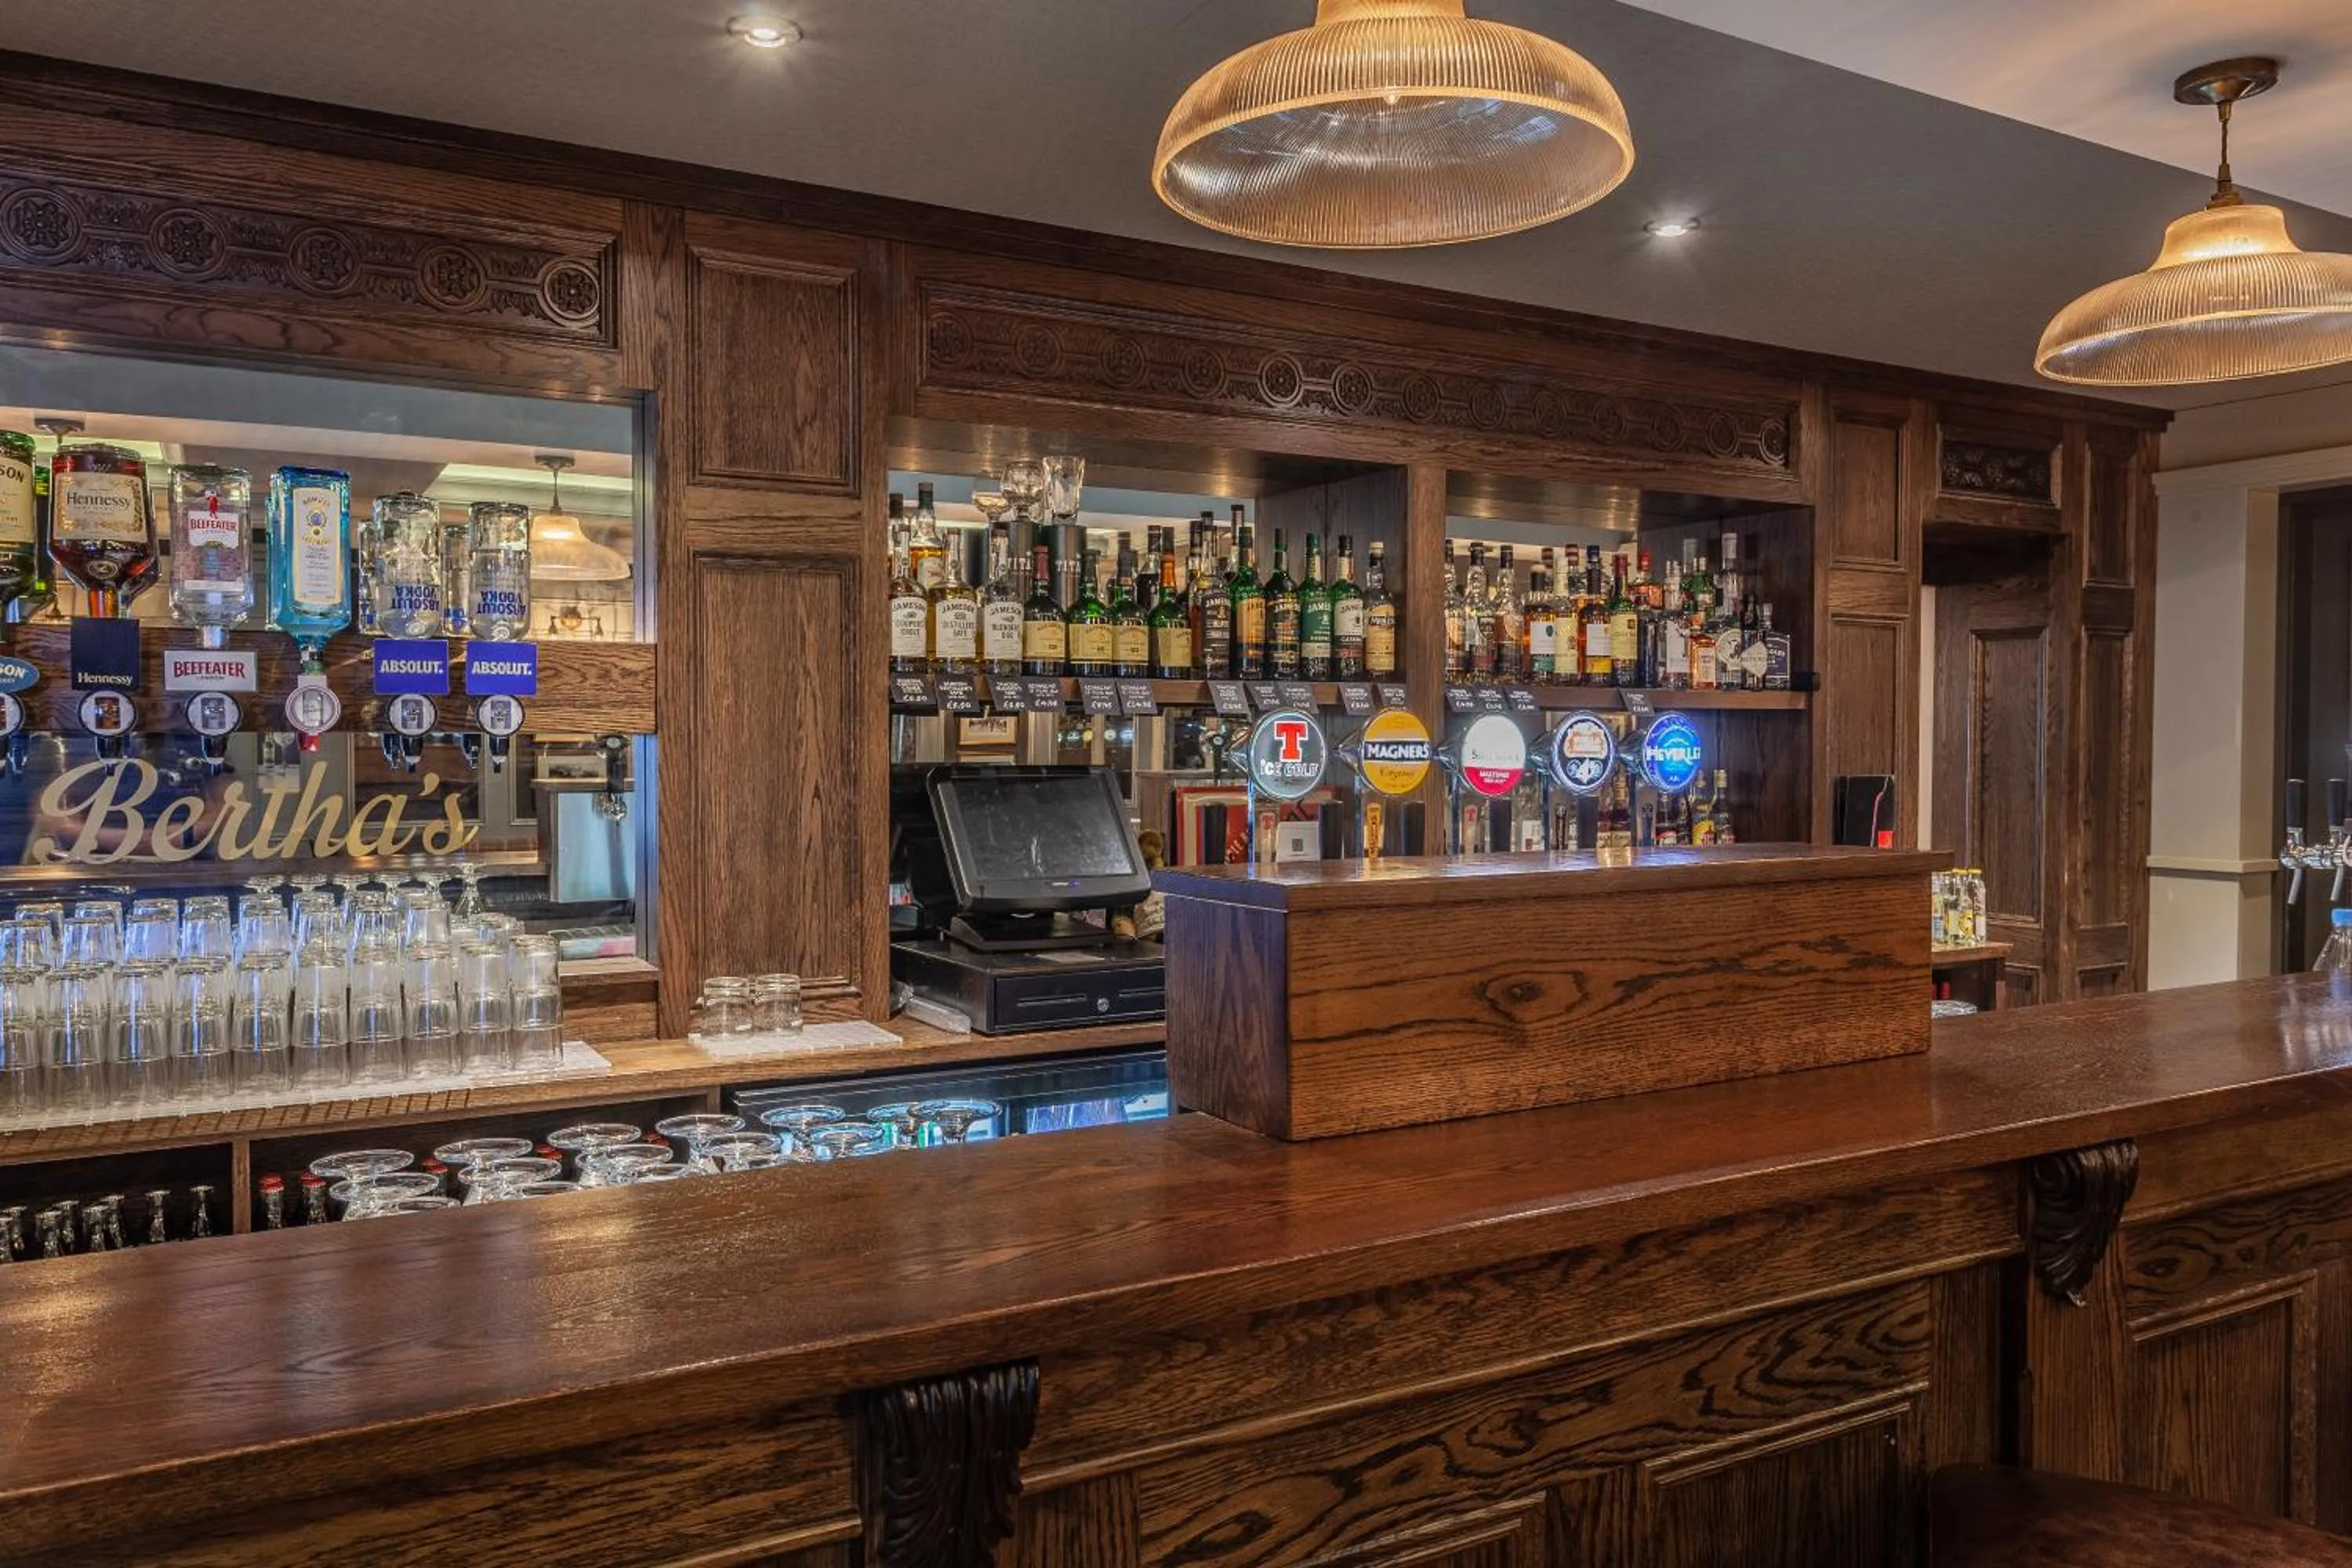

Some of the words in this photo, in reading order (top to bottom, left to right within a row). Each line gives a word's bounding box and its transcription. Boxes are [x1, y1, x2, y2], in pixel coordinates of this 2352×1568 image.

[67, 492, 129, 509] Hennessy
[191, 518, 238, 532] BEEFEATER
[394, 586, 438, 601] VODKA
[481, 590, 523, 604] VODKA
[476, 603, 527, 617] ABSOLUT
[173, 661, 245, 679] BEEFEATER
[78, 672, 133, 687] Hennessy
[1274, 720, 1308, 763] T
[1367, 742, 1431, 760] MAGNERS
[31, 759, 480, 866] Bertha's
